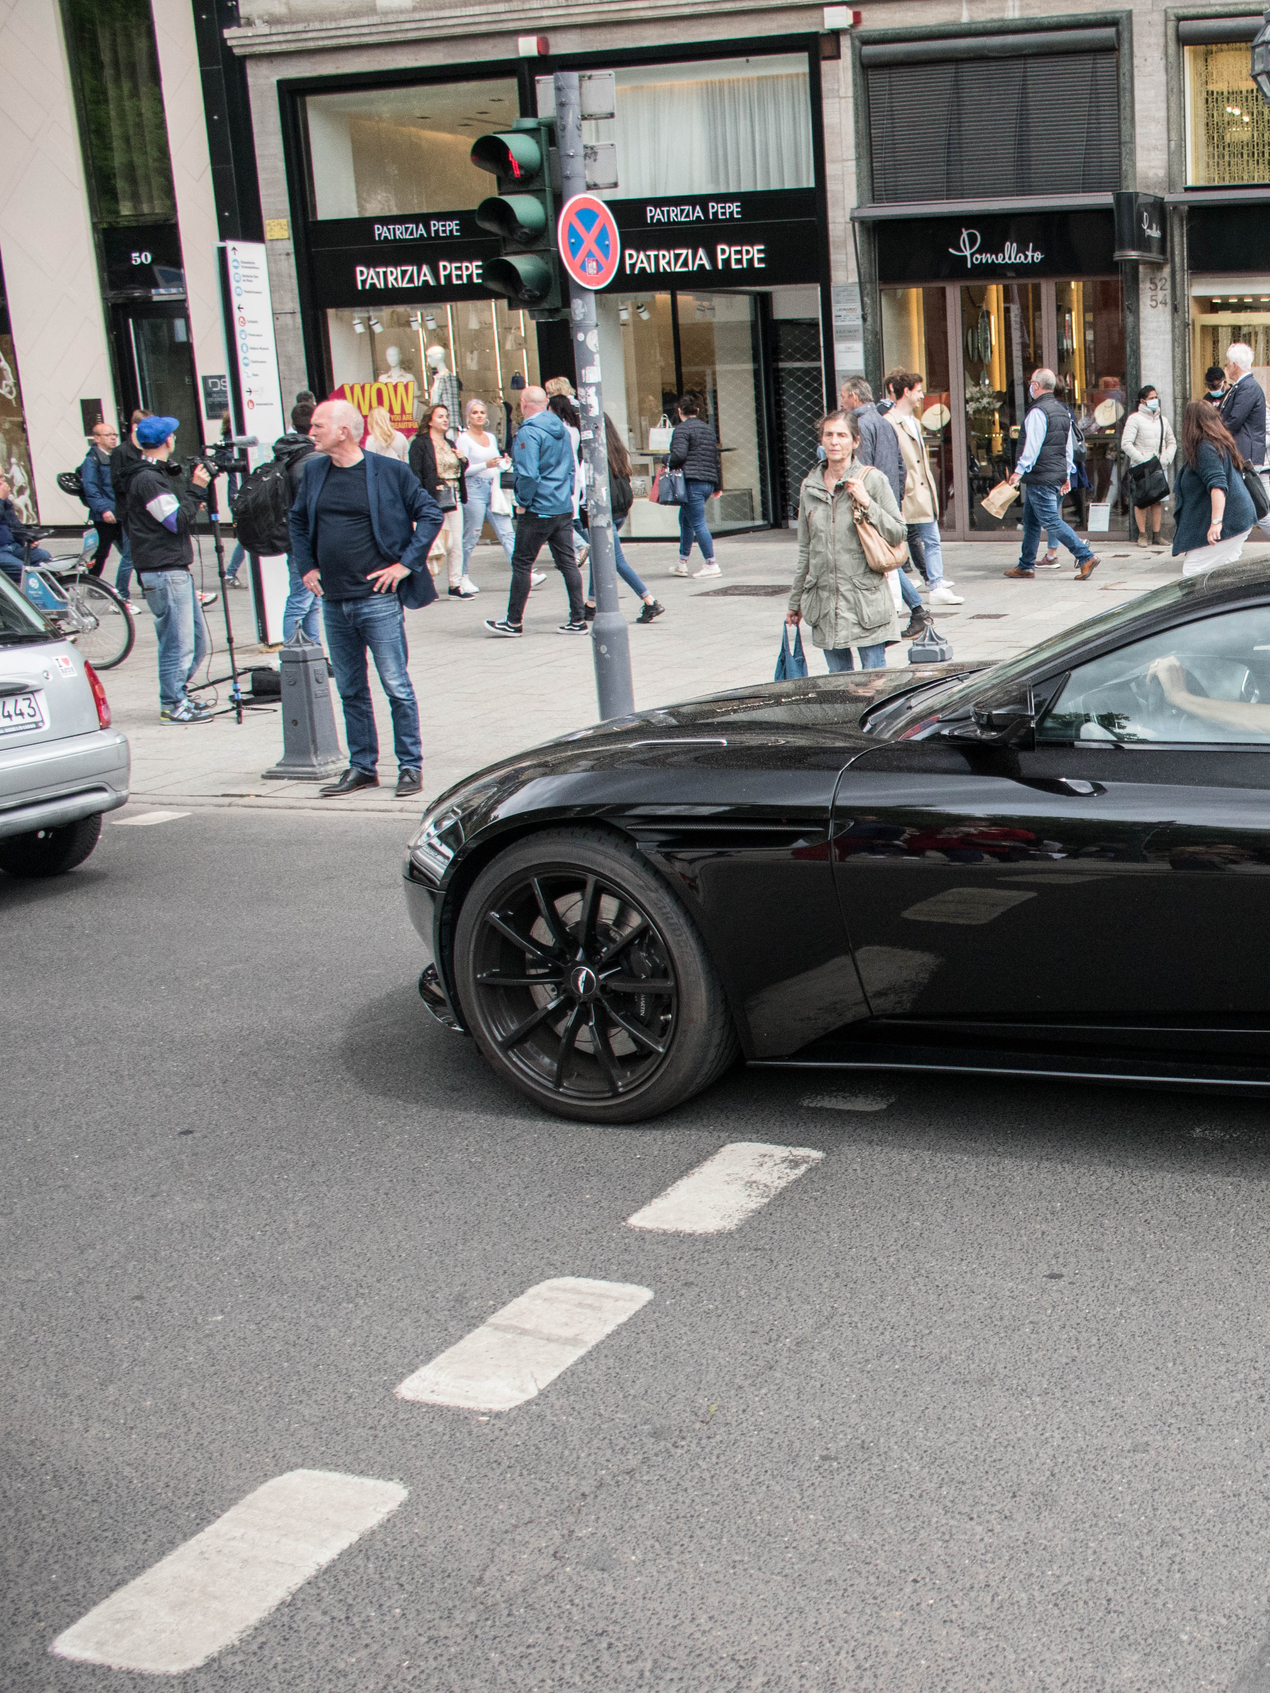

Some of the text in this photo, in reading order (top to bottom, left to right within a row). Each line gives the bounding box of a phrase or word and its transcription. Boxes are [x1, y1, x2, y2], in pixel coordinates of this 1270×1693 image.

[646, 202, 742, 224] PATRIZIA PEPE
[374, 220, 461, 241] PATRIZIA PEPE
[130, 251, 152, 266] 50
[948, 227, 1045, 269] Pomellato
[625, 243, 766, 275] PATRIZIA PEPE
[355, 261, 483, 291] PATRIZIA PEPE
[1149, 277, 1168, 291] 52
[1149, 294, 1169, 308] 54
[343, 381, 415, 416] WOW
[402, 413, 413, 421] ARE
